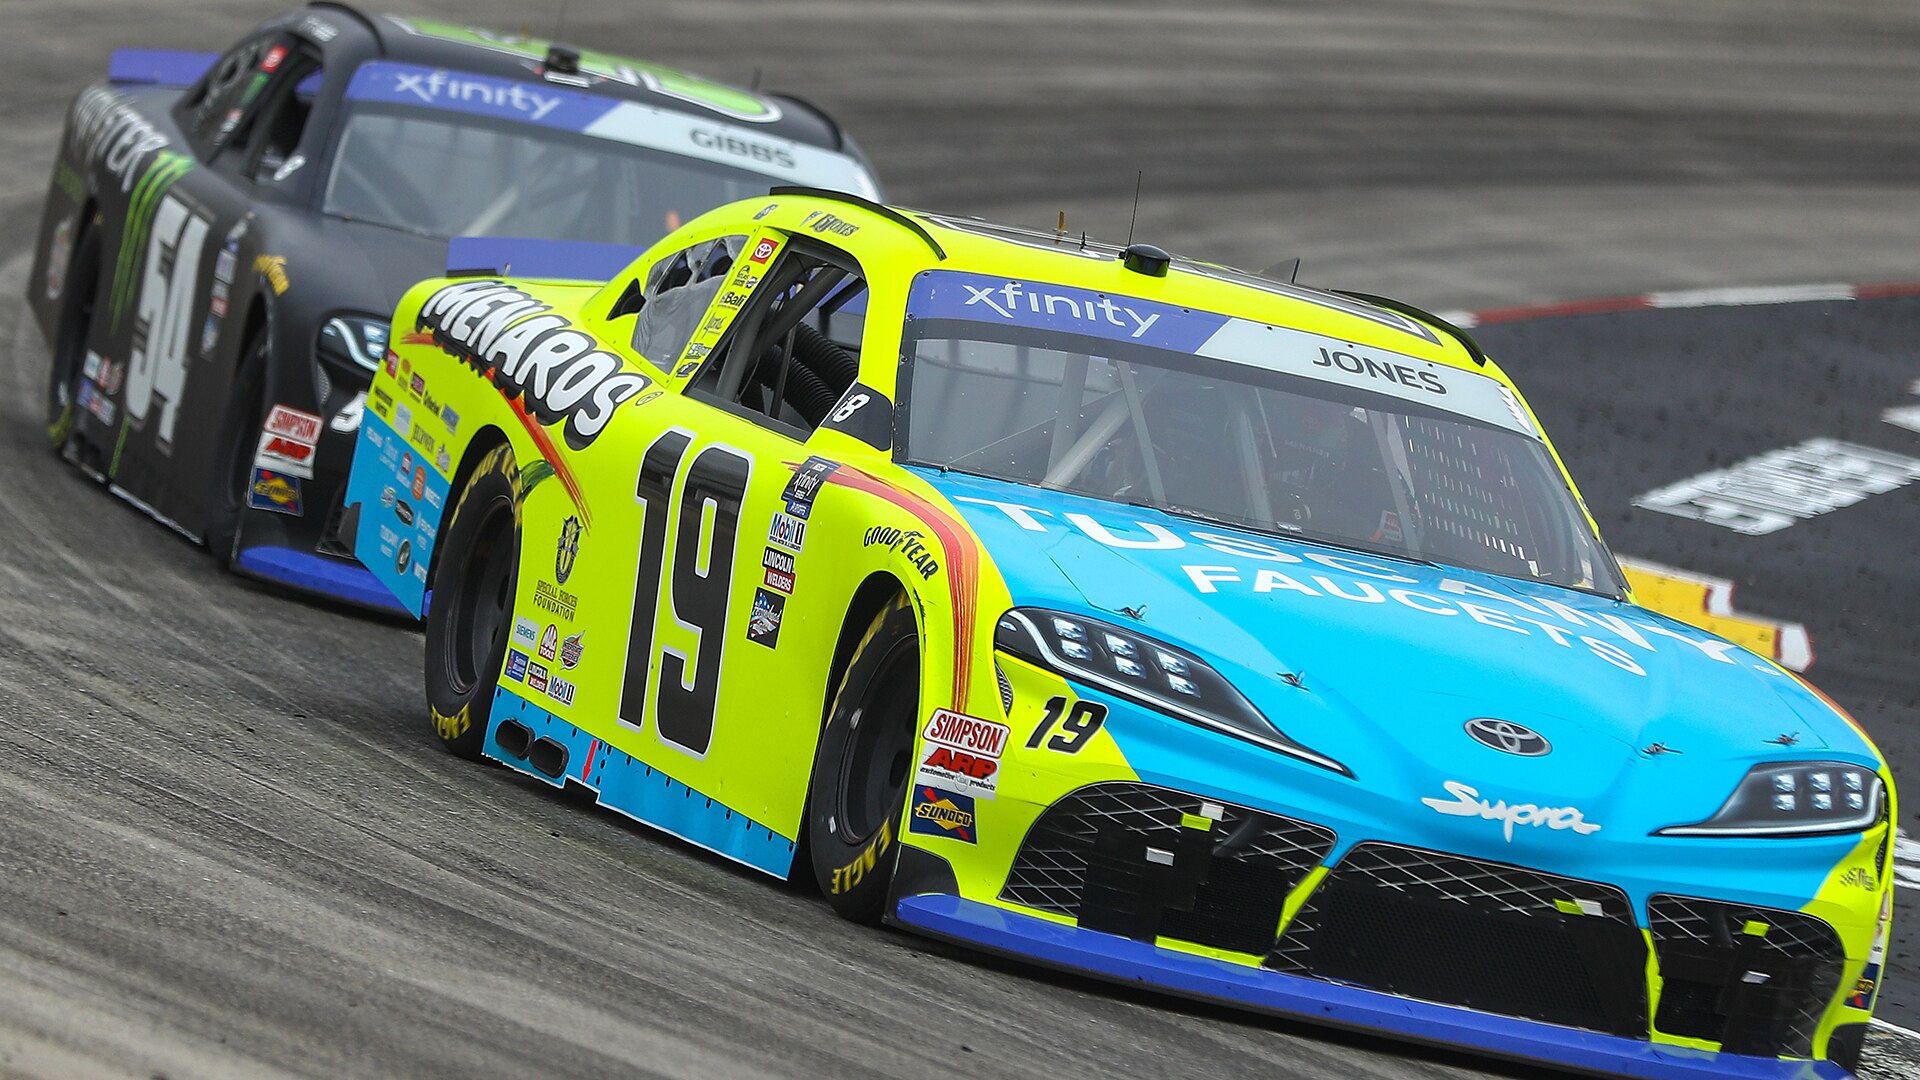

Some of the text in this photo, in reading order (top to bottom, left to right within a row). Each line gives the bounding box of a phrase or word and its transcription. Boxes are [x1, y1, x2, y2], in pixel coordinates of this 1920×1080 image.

[394, 69, 561, 120] xfinity
[690, 127, 797, 169] GIBBS
[127, 194, 209, 443] 54
[724, 292, 747, 306] Bali
[962, 281, 1160, 338] xfinity
[1312, 346, 1449, 397] JONES
[770, 513, 797, 542] Mobil
[764, 550, 793, 573] LINCOLN
[864, 526, 939, 581] GOODYEAR
[619, 430, 750, 757] 19
[767, 571, 792, 591] WELDERS
[954, 496, 1738, 665] TUSCANY
[533, 594, 575, 622] FOUNDATION
[1181, 564, 1648, 677] FAUCETS
[516, 624, 535, 641] SIEMENS
[539, 646, 556, 660] TOOLS
[931, 713, 1004, 754] SIMPSON
[1026, 697, 1109, 755] 19
[920, 767, 996, 791] automotive products
[922, 747, 997, 780] ARP
[917, 805, 973, 827] SUNOCO
[1421, 781, 1601, 843] Supra
